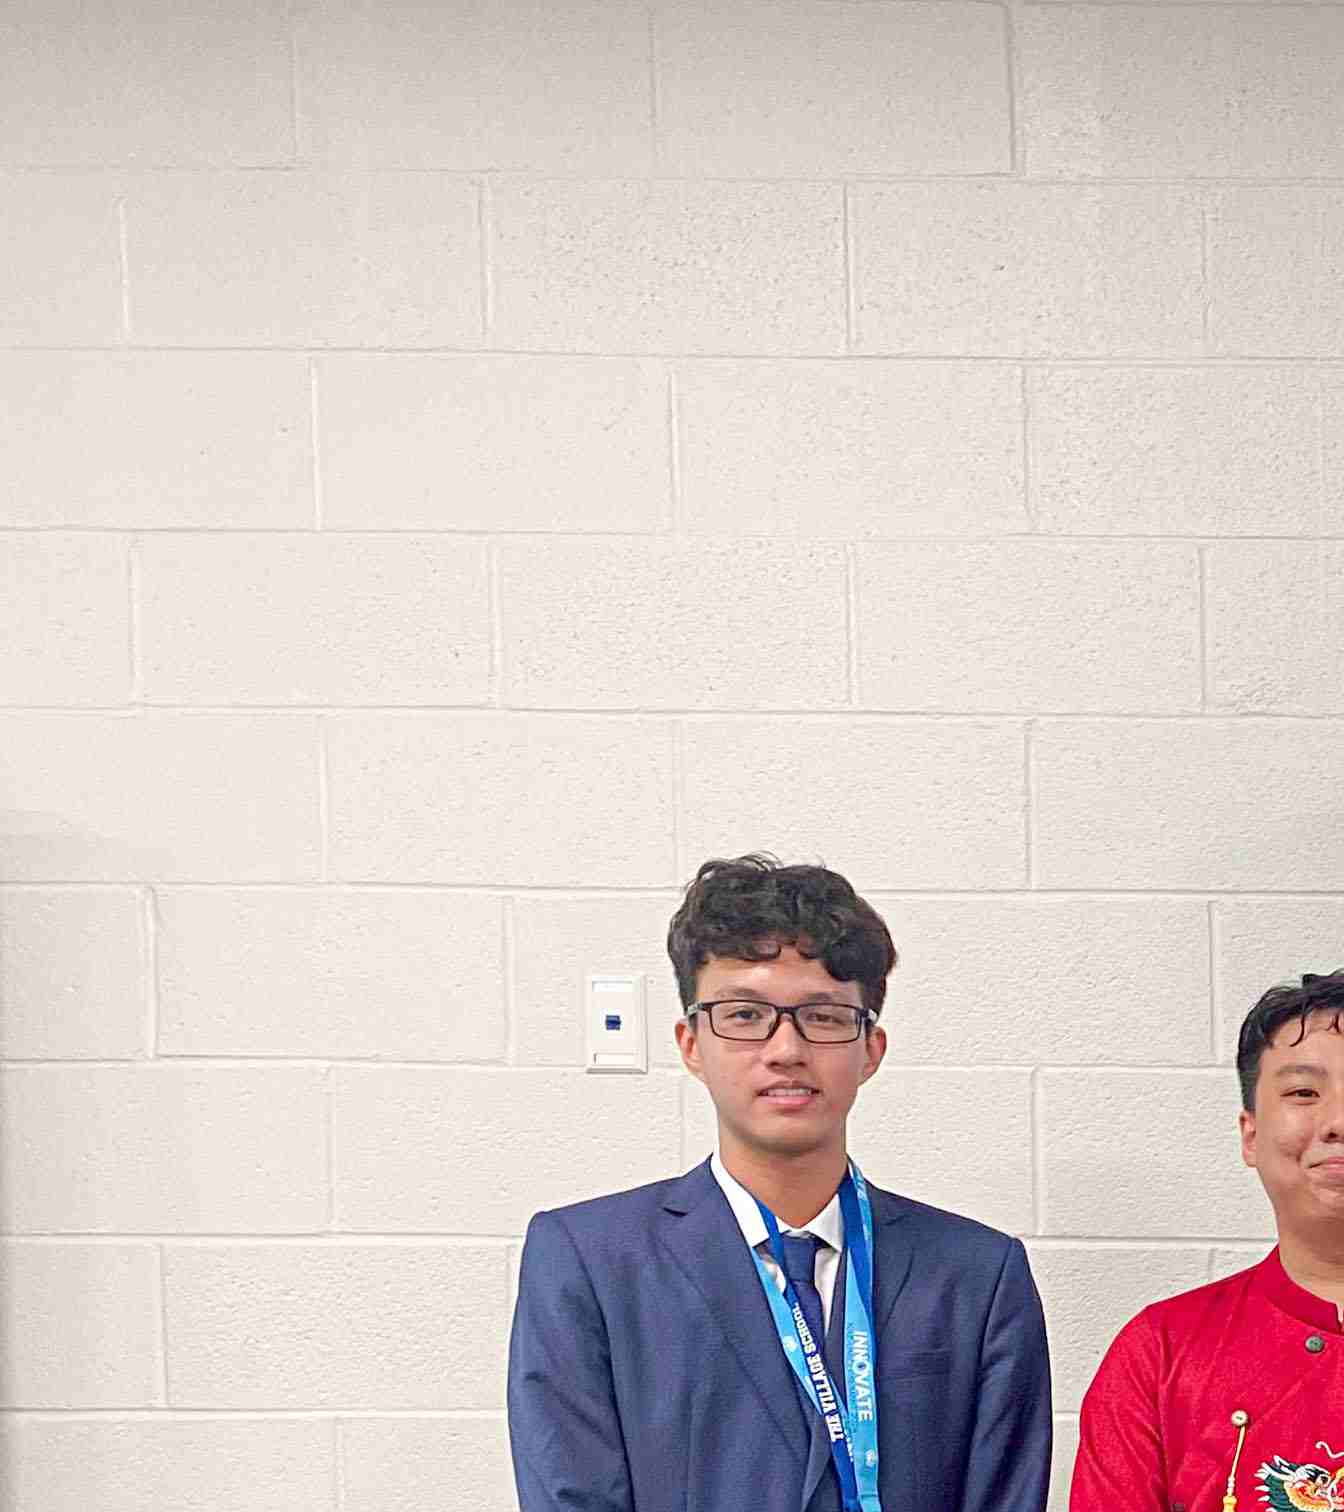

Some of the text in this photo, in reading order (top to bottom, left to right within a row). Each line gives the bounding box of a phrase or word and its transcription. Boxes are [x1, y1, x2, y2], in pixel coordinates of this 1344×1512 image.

[792, 1303, 844, 1442] THE VILLAGE SCHOOL
[851, 1331, 872, 1421] INNOVATE
